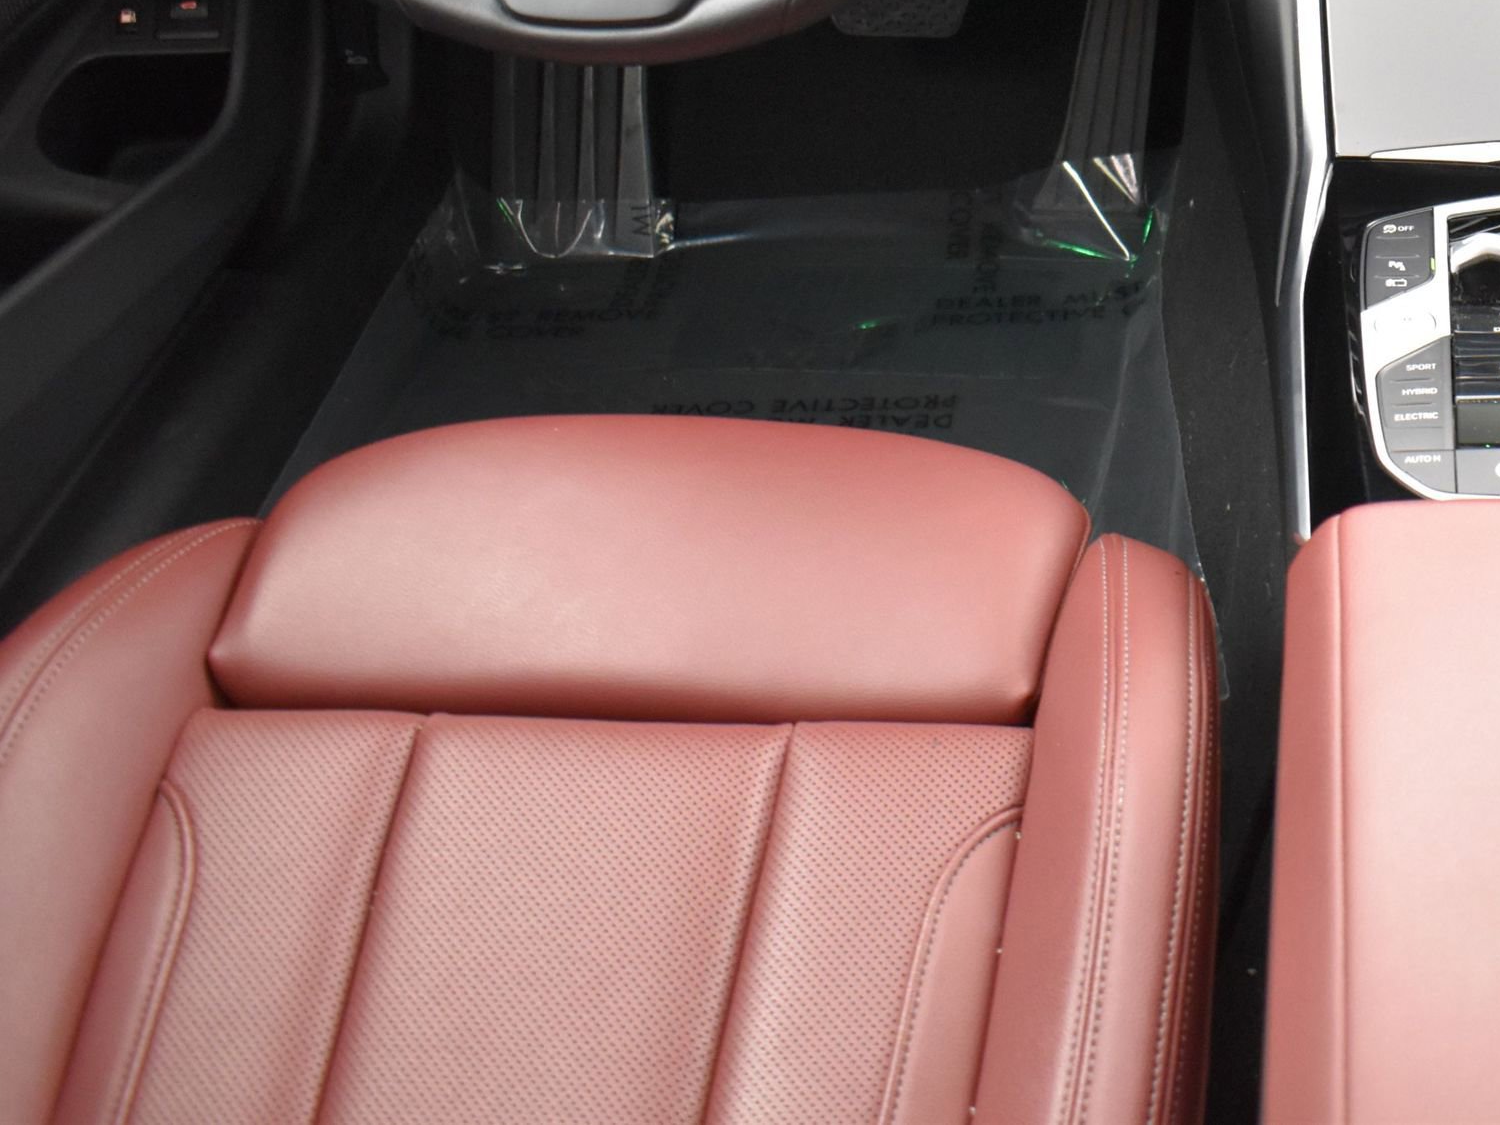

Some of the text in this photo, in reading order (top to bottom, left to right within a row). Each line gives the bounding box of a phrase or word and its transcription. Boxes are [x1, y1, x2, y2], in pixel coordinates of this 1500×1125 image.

[1406, 363, 1437, 371] SPORT
[1402, 387, 1438, 396] HYBRID
[1394, 411, 1439, 422] ELECTRIC
[1404, 455, 1442, 464] AUTO H
